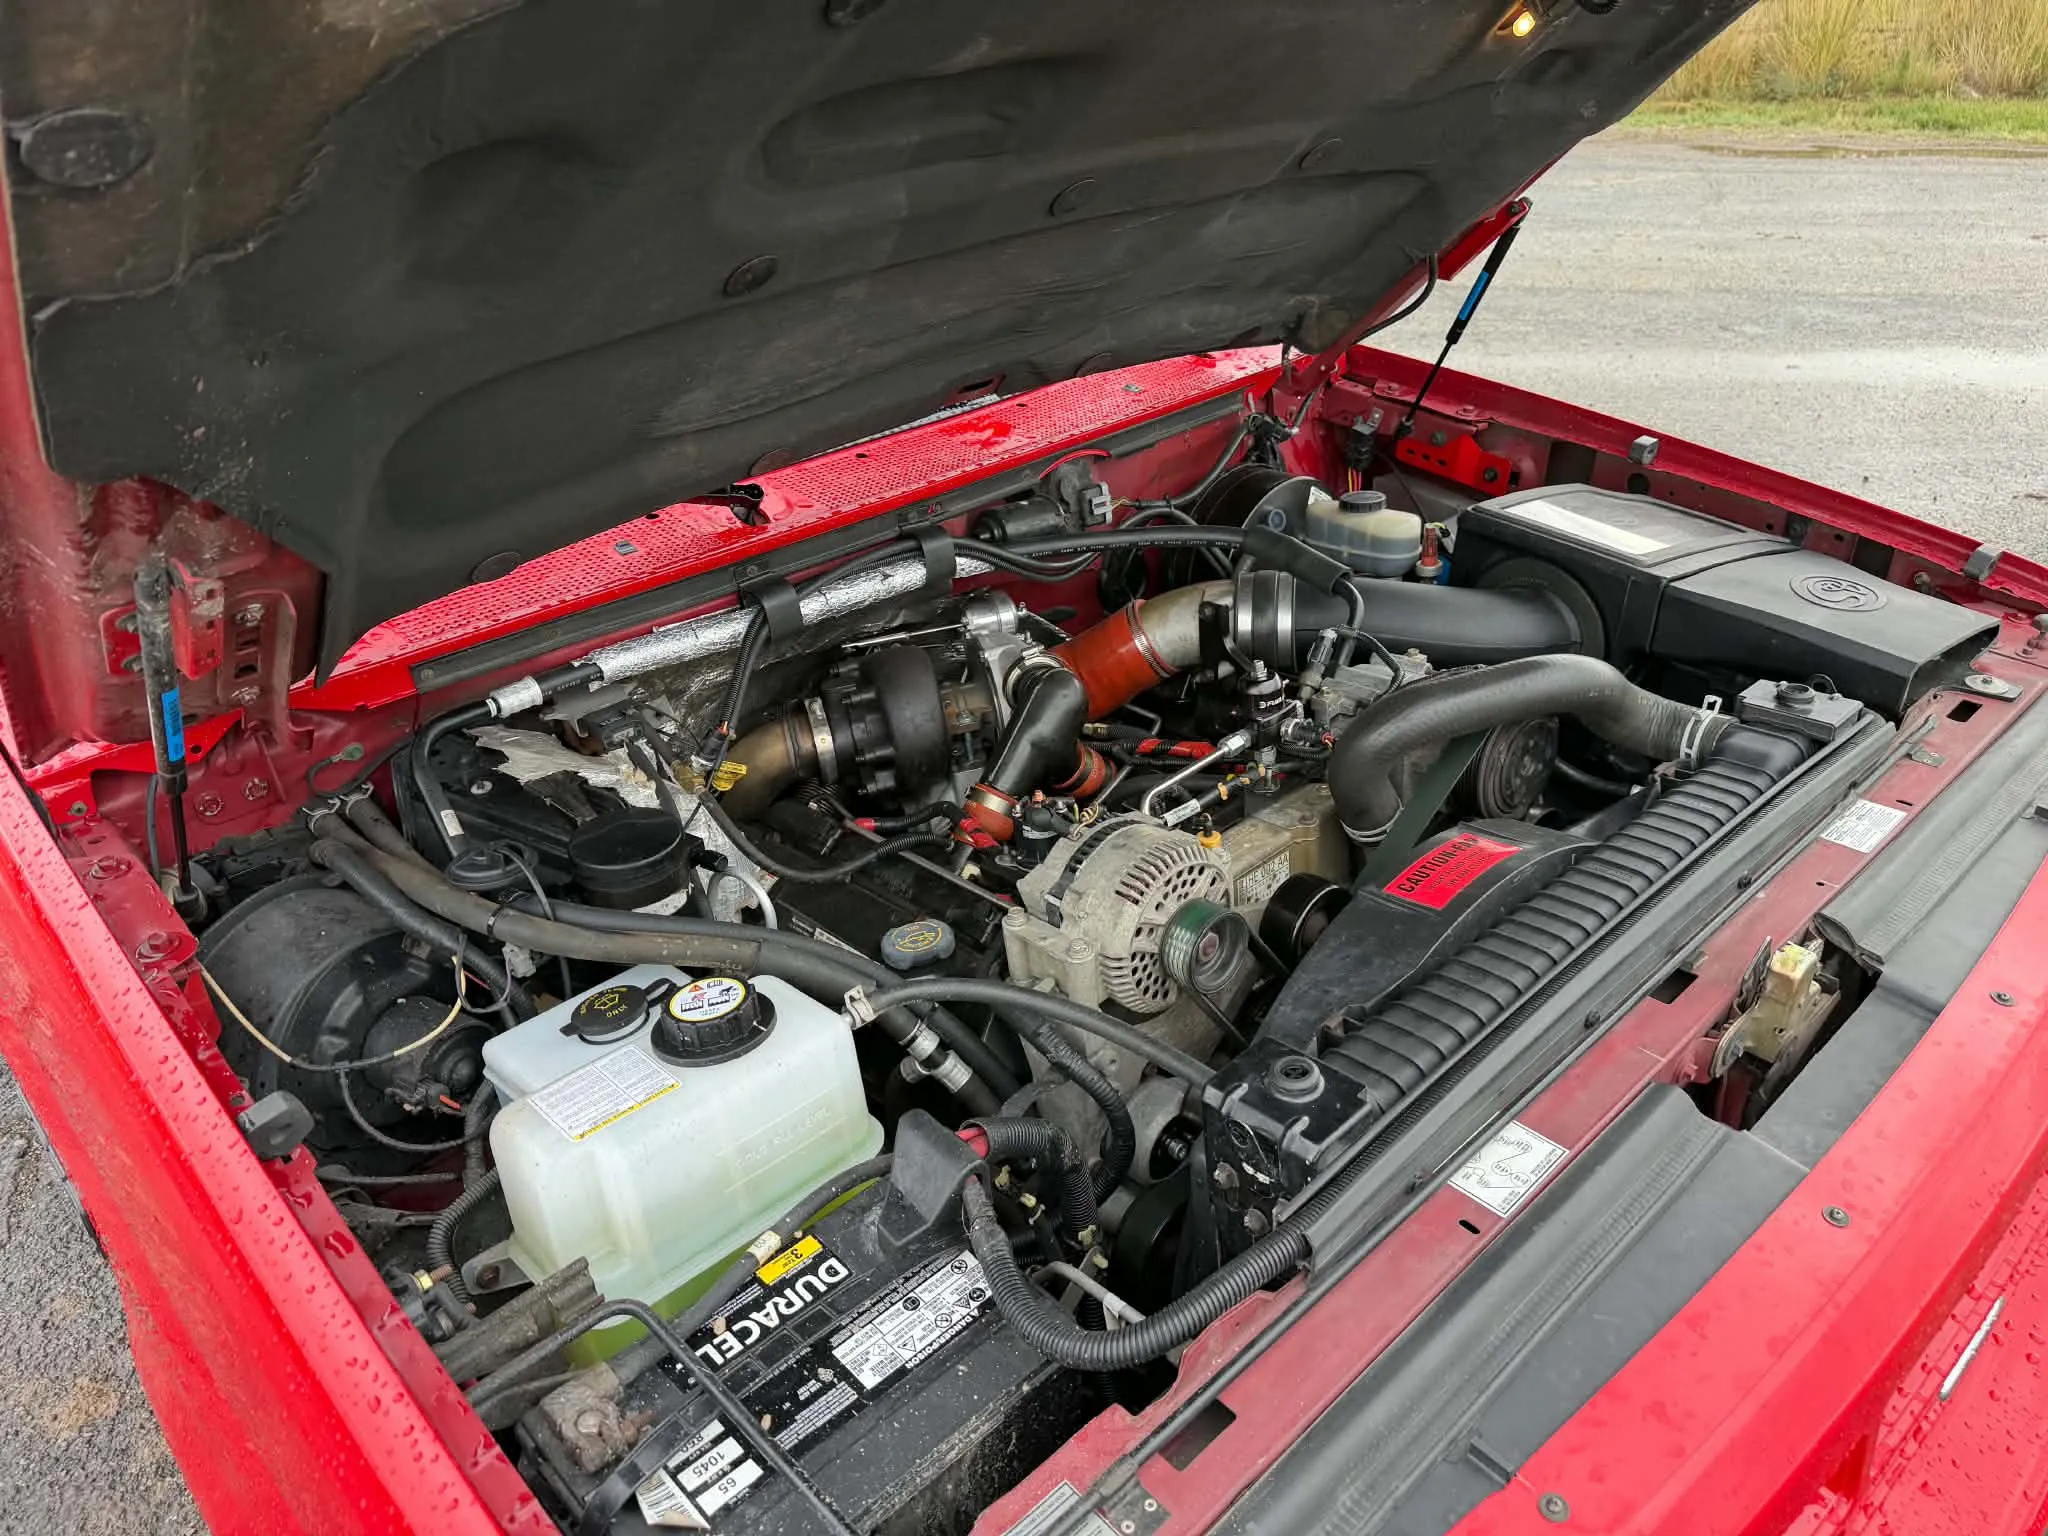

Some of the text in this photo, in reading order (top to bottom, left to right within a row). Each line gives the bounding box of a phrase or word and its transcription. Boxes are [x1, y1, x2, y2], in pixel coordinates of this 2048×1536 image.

[790, 1248, 803, 1260] 3
[676, 1257, 850, 1372] DURACEL
[692, 1451, 726, 1478] 1045
[718, 1477, 737, 1495] 65
